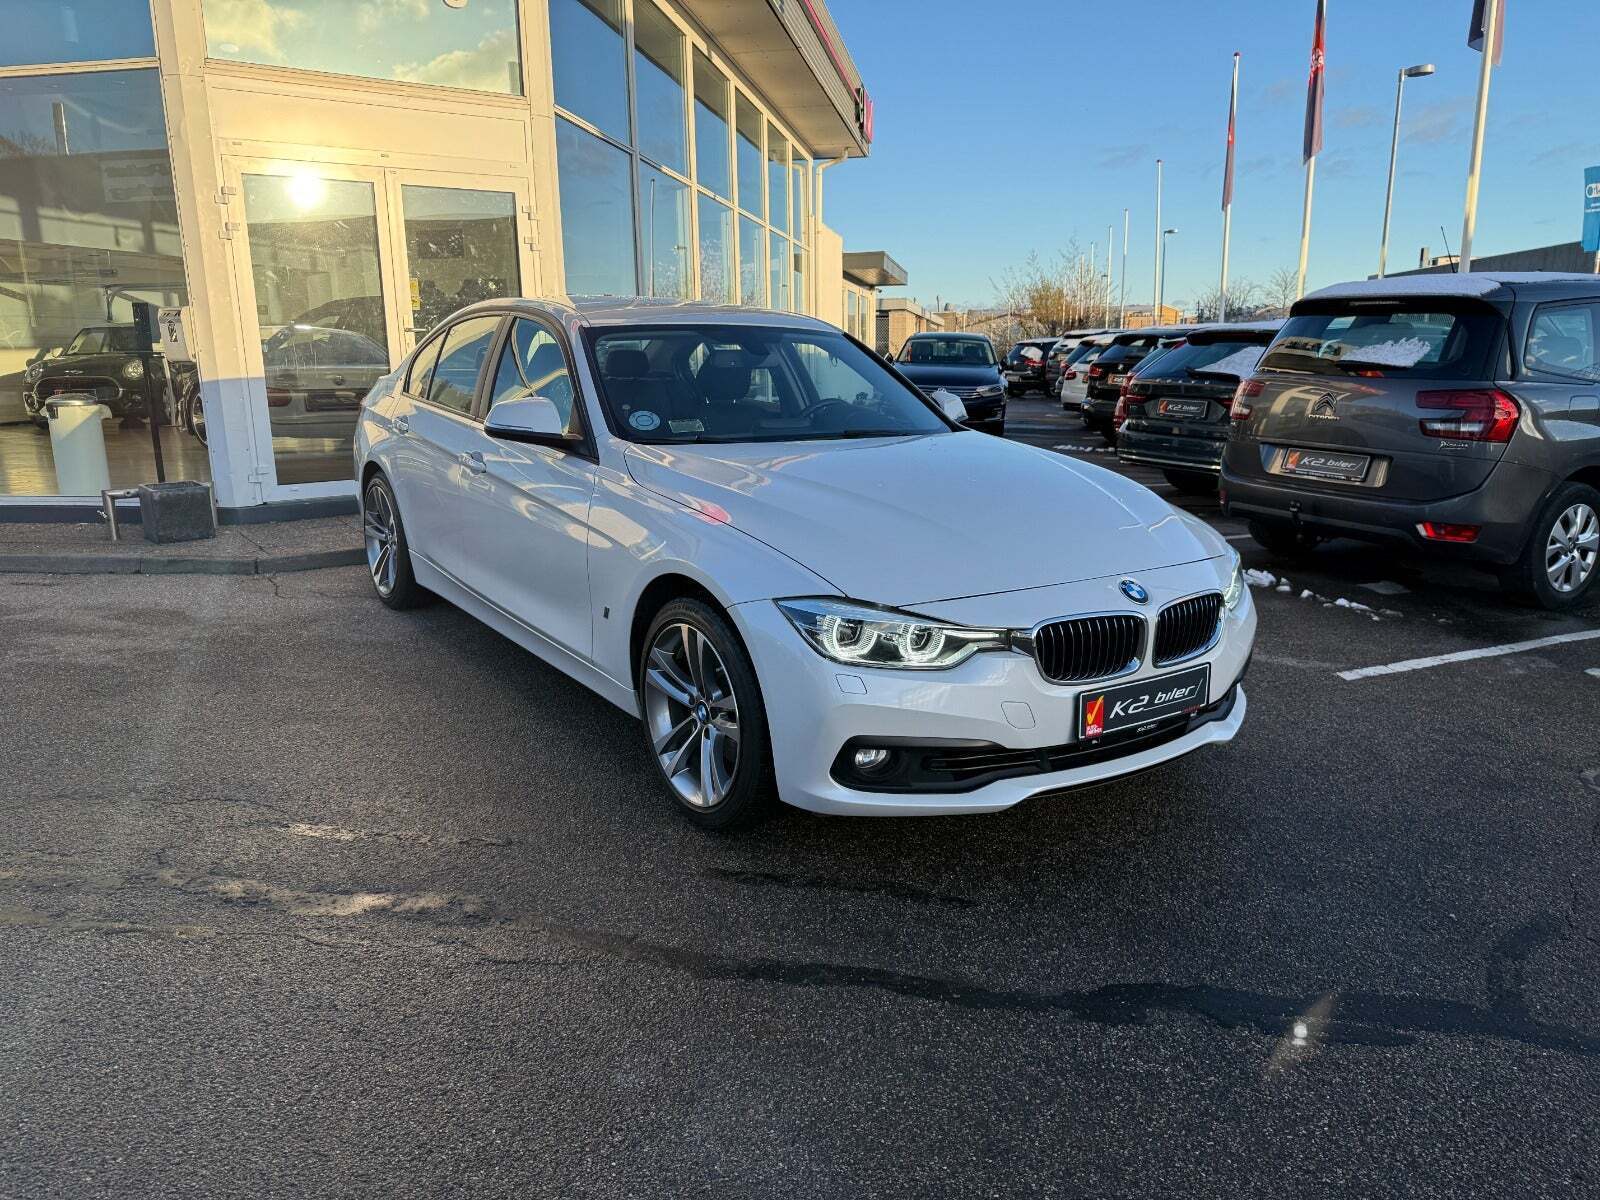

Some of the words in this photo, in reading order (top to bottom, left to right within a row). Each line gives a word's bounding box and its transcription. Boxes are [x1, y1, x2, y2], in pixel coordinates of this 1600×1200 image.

[1300, 456, 1325, 466] K2
[1327, 459, 1357, 468] biler
[1109, 695, 1150, 719] K2
[1154, 685, 1197, 704] biler
